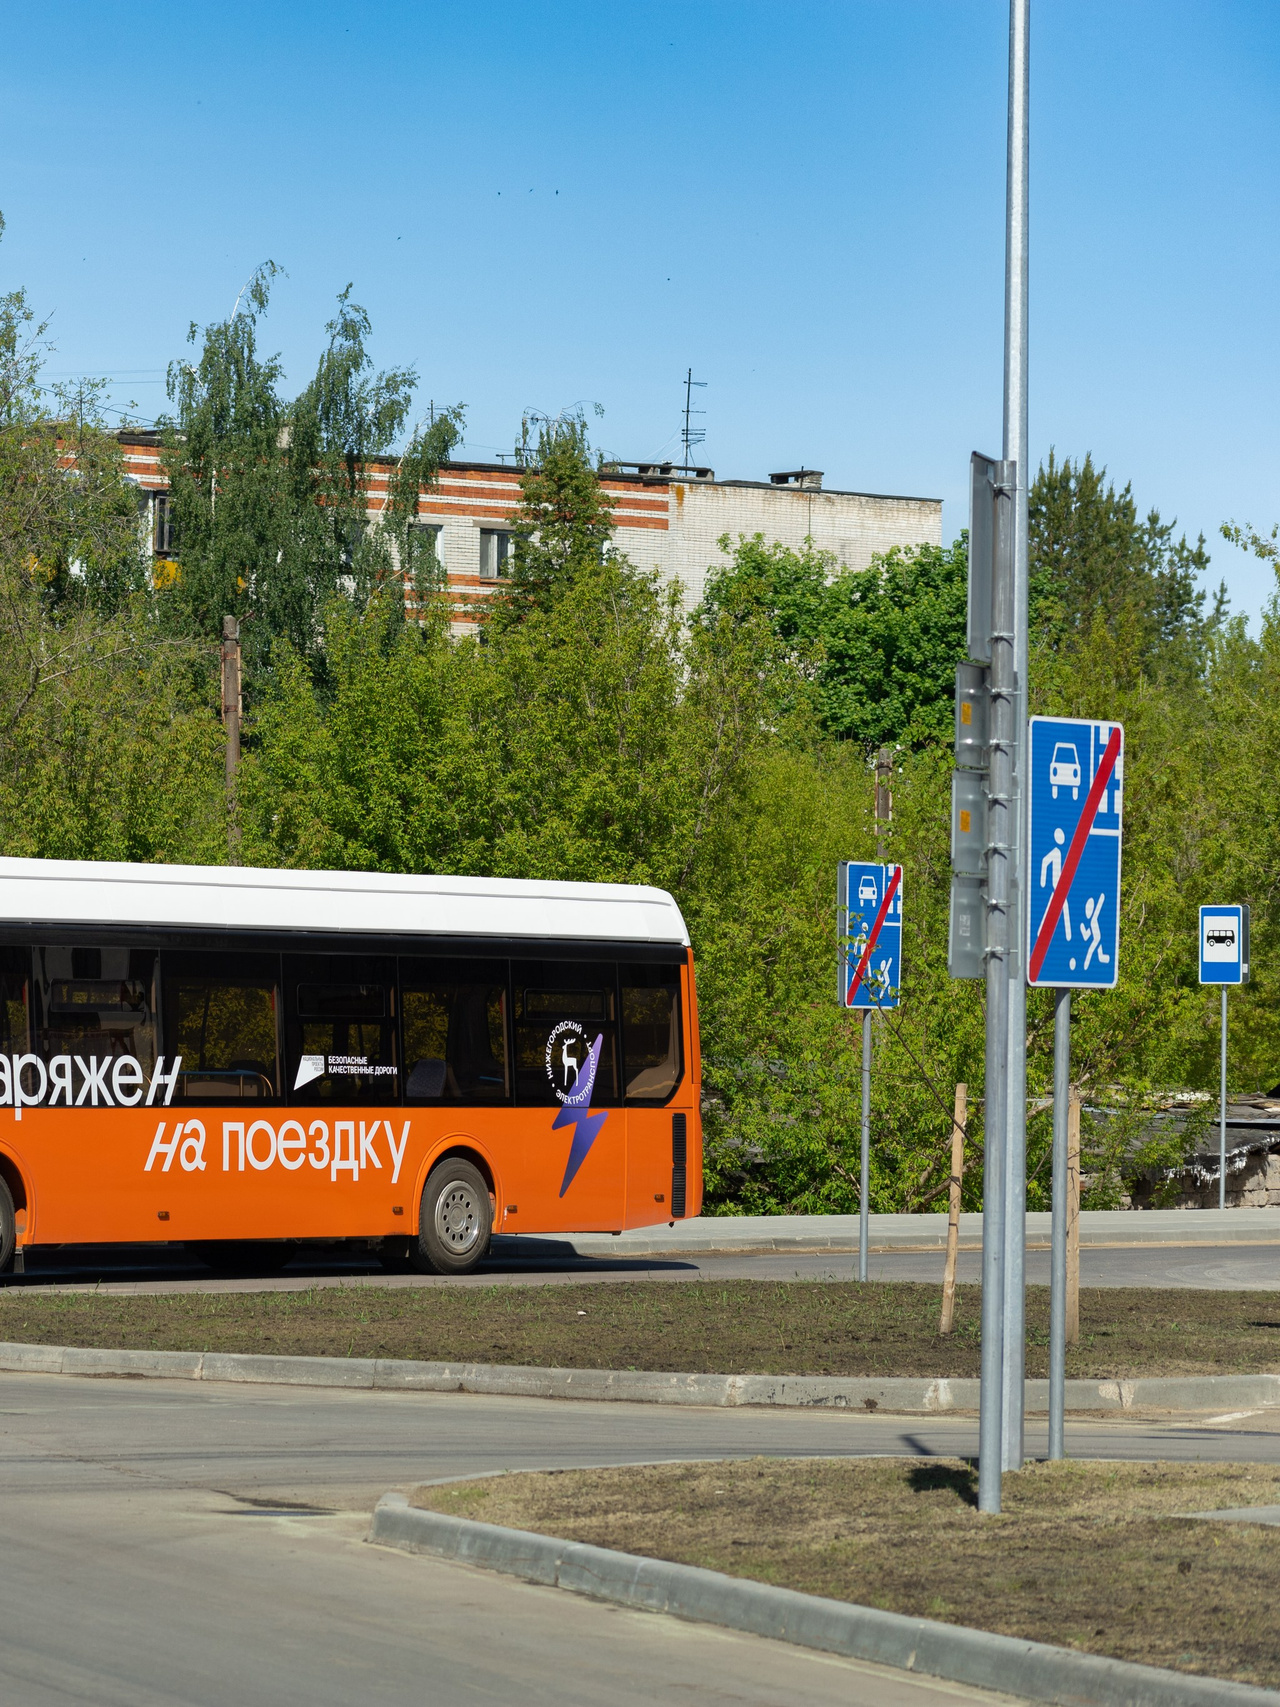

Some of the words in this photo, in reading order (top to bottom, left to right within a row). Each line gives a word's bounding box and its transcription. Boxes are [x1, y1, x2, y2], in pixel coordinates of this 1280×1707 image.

[328, 1056, 368, 1065] БЕЗОПАСНЫЕ
[328, 1065, 374, 1075] КАЧЕСТВЕННЫЕ
[375, 1066, 398, 1076] ДОРОГИ
[545, 1020, 583, 1080] НИЖЕГОРОДСКИЙ
[555, 1041, 596, 1105] ЭЛЕКТРОТРАНСПОРТ
[144, 1119, 207, 1172] на
[222, 1120, 411, 1184] поездку
